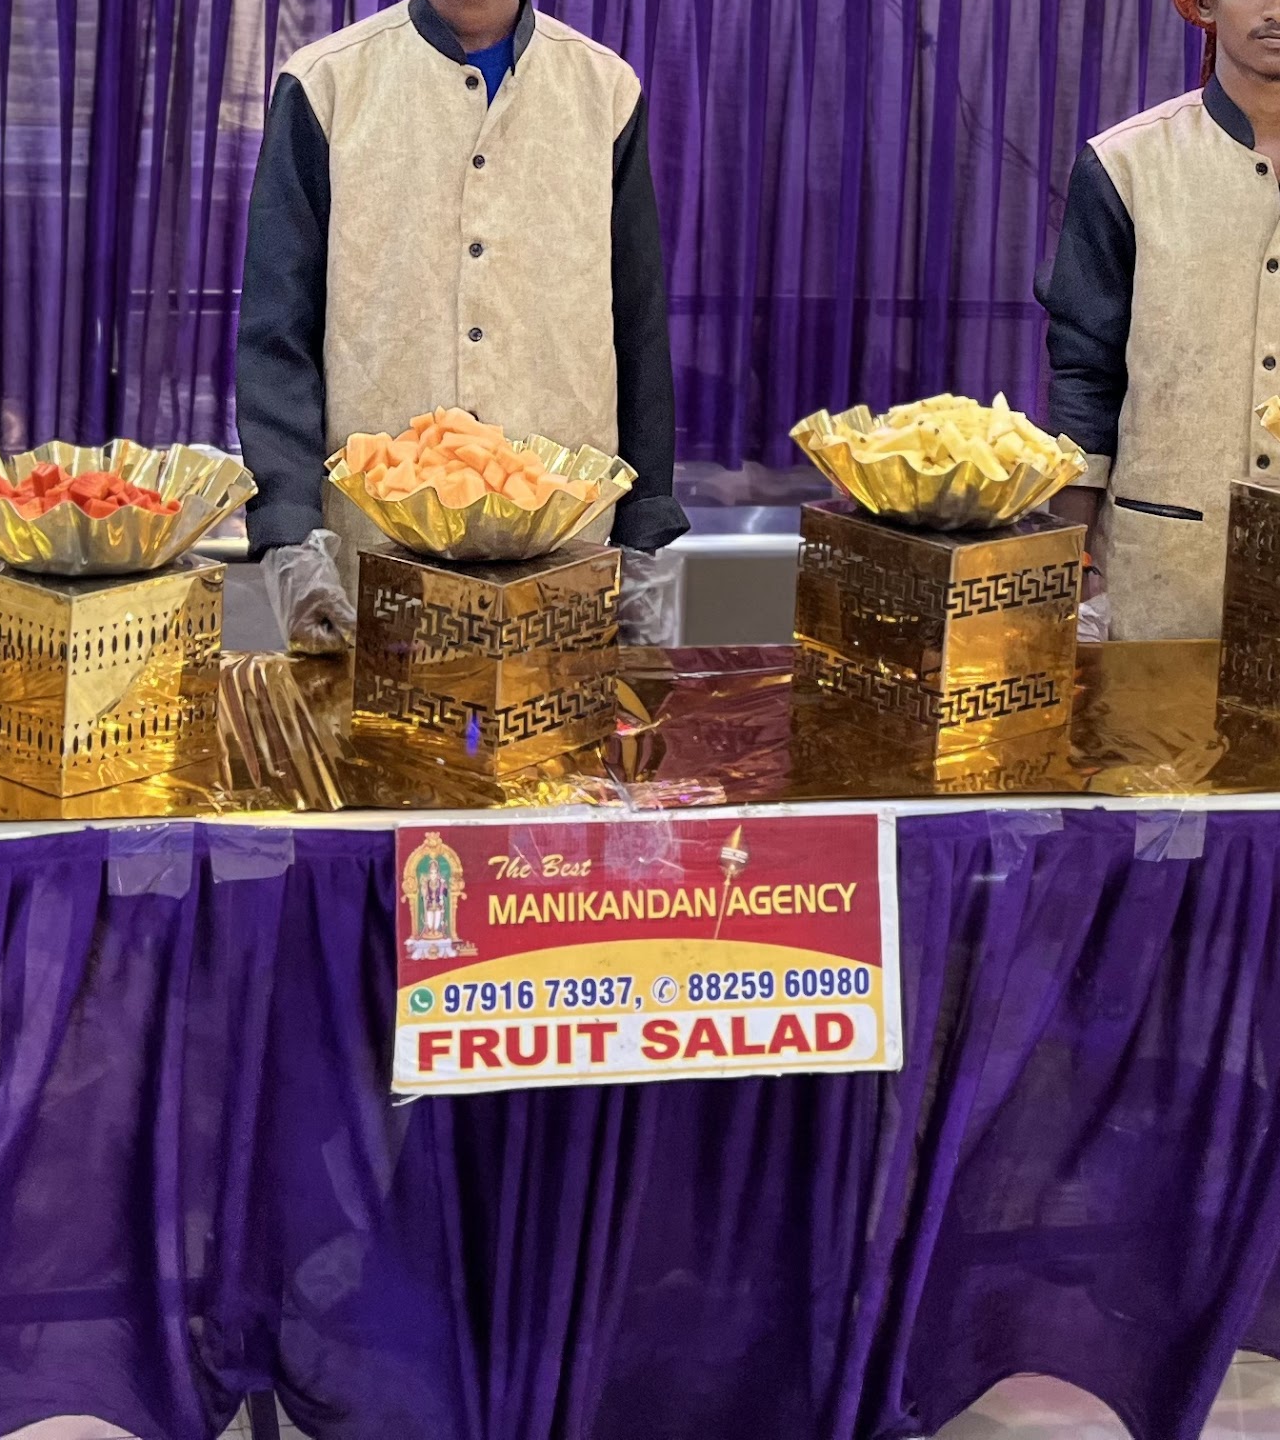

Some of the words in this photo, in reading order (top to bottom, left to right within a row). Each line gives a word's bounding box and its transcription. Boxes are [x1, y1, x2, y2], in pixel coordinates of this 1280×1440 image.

[488, 855, 532, 880] The
[542, 854, 592, 878] Best
[488, 887, 717, 926] MANIKANDAN
[725, 882, 858, 917] AGENCY
[444, 980, 535, 1013] 97916
[544, 976, 643, 1010] 73937,
[688, 971, 774, 1002] 88259
[784, 967, 870, 998] 60980
[418, 1022, 618, 1072] FRUIT
[640, 1012, 854, 1060] SALAD
